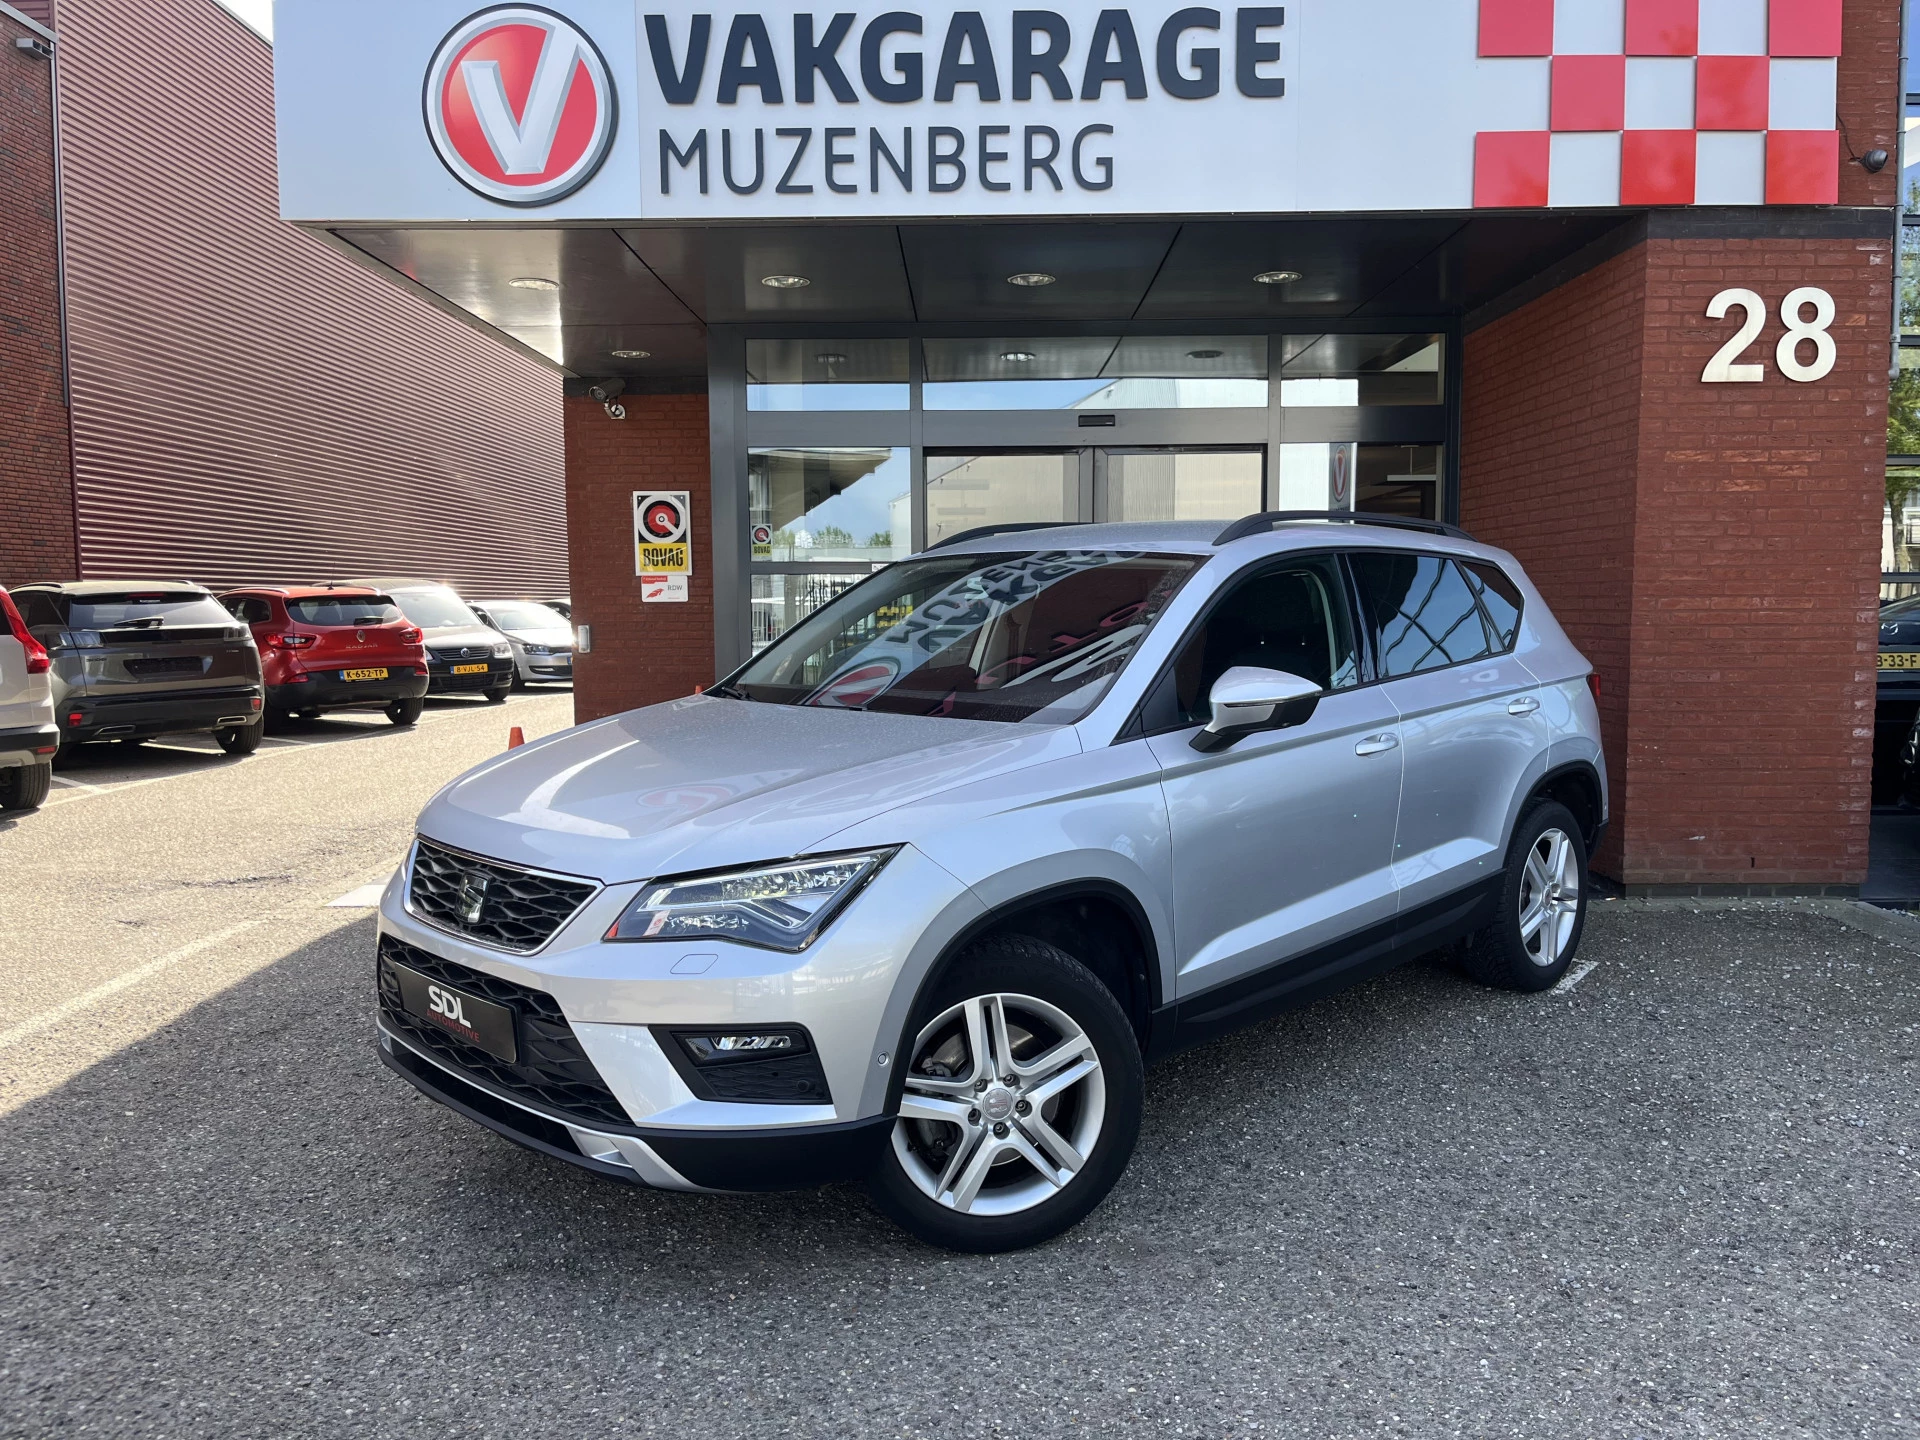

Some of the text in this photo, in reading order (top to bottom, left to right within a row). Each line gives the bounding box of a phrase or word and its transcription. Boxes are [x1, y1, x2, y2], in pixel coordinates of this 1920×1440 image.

[644, 7, 1285, 105] VAKGARAGE
[659, 123, 1115, 195] MUZENBERG
[1701, 286, 1837, 384] 28
[643, 548, 684, 567] BOVAG
[753, 546, 770, 554] BOVAG
[346, 669, 384, 678] K-652-TP
[426, 1009, 480, 1042] AUTOMOTIVE
[428, 985, 472, 1028] SDL
